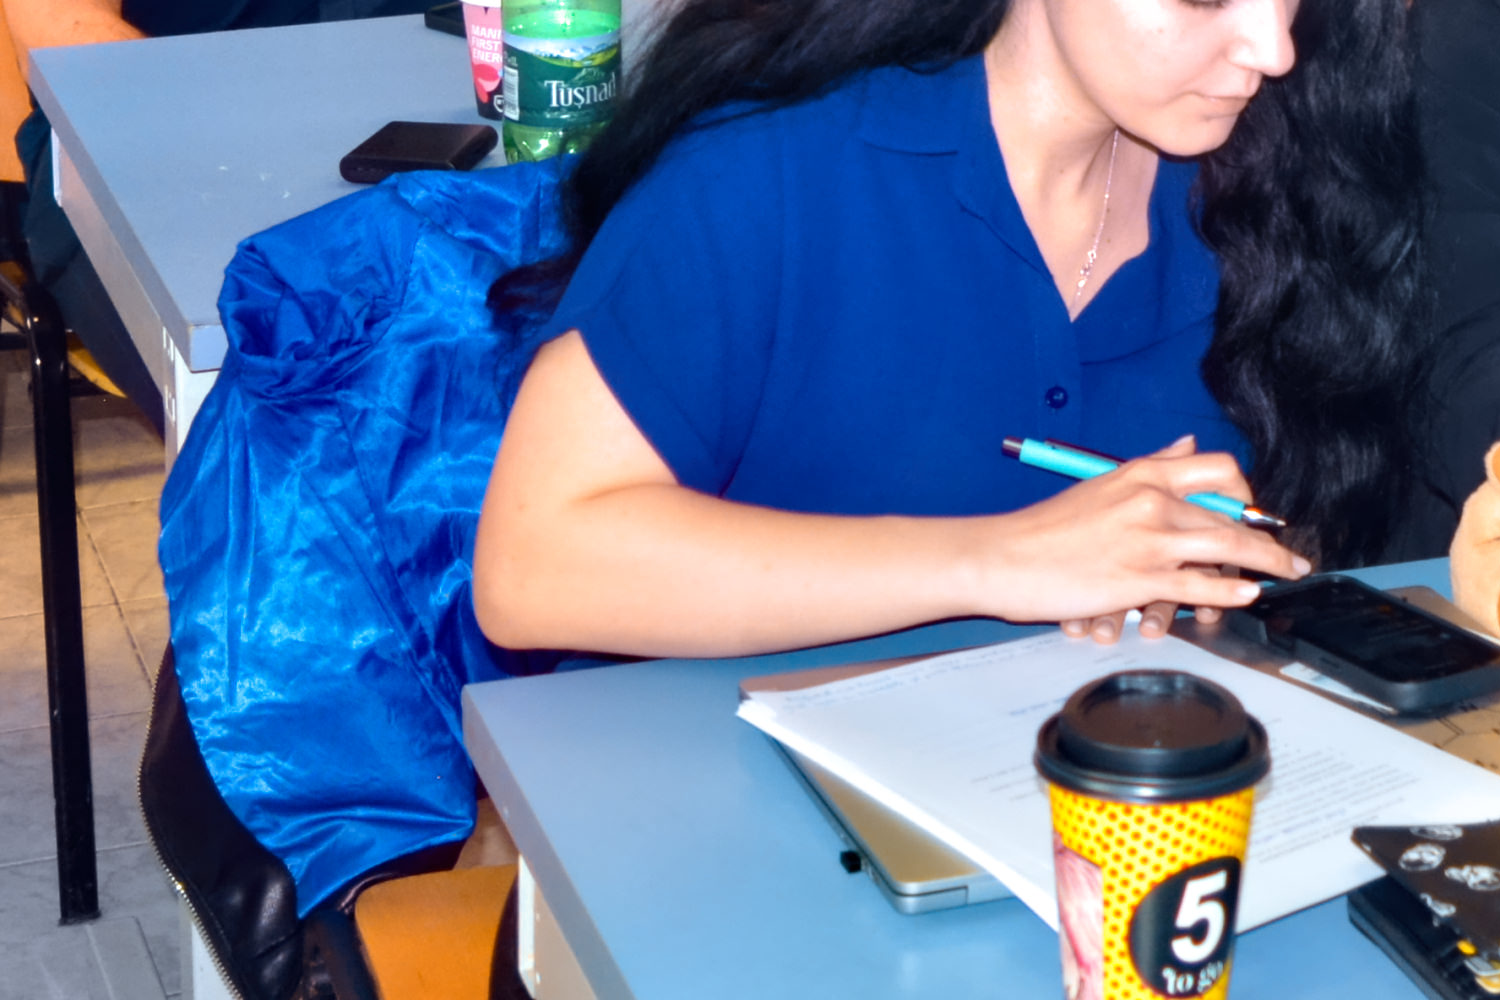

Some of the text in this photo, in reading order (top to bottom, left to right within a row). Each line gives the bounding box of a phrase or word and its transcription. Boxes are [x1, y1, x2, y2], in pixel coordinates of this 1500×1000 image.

[472, 35, 501, 52] FIRST
[472, 48, 504, 63] ENER
[1172, 870, 1227, 963] 5
